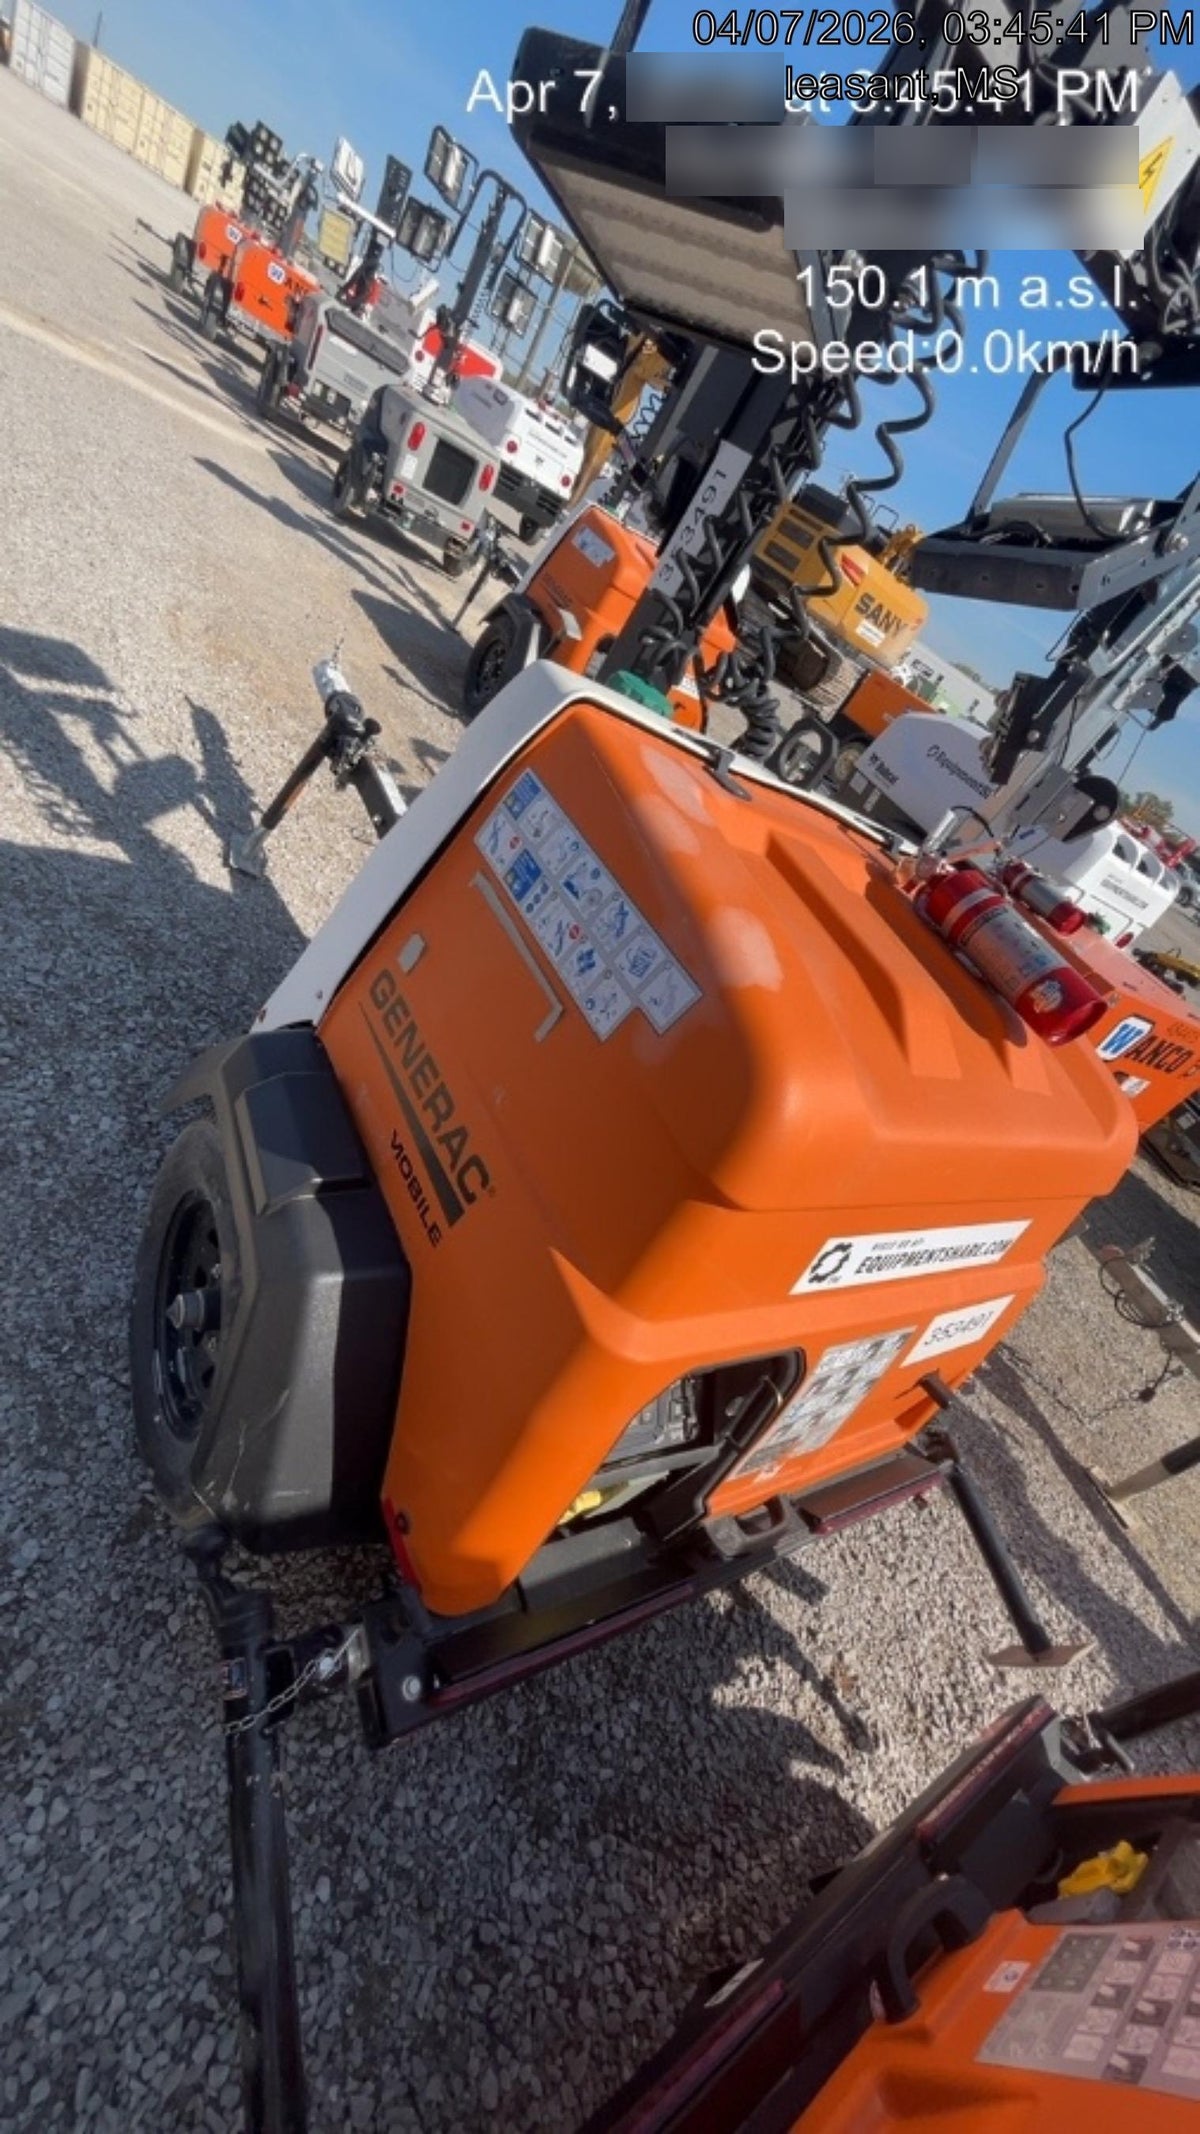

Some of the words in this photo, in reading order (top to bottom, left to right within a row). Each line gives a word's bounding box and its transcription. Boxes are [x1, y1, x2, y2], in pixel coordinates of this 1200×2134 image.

[1098, 1020, 1194, 1075] WANCO
[369, 968, 491, 1206] GENERAC
[854, 1238, 1013, 1275] EQUIPMENTSHARE.COM
